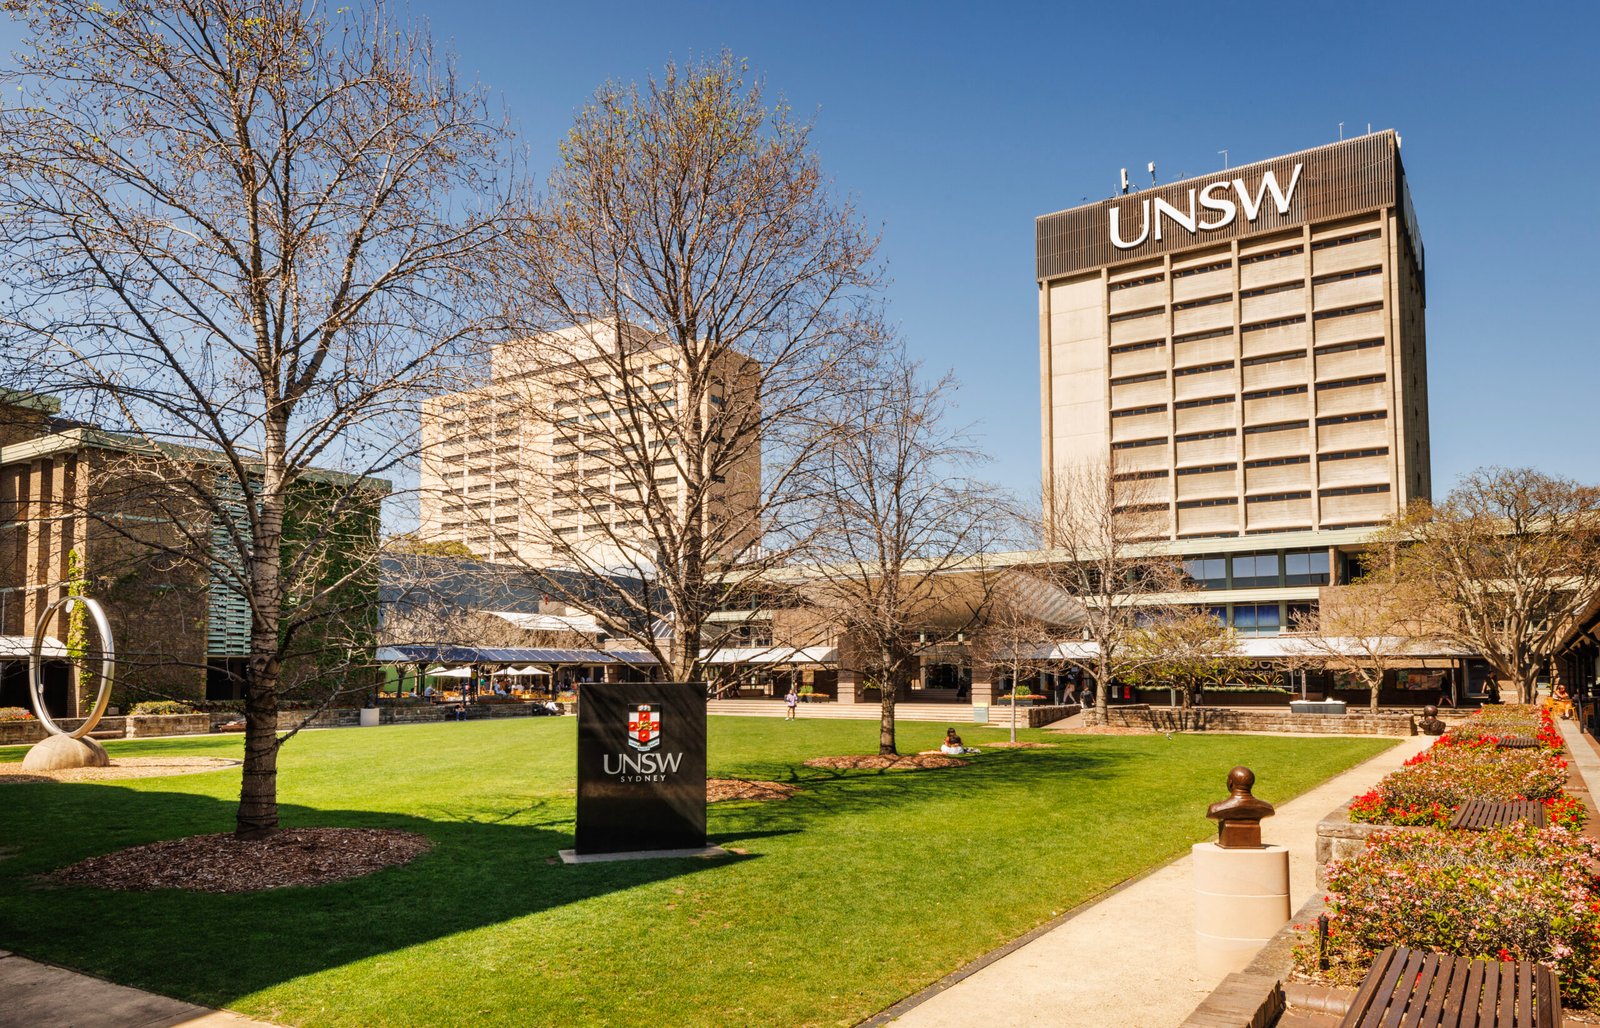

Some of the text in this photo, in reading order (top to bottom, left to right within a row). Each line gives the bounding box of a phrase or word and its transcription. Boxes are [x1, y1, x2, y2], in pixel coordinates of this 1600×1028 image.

[1109, 163, 1303, 248] UNSW
[603, 753, 683, 774] UNSW
[620, 775, 666, 783] SYDNEY
